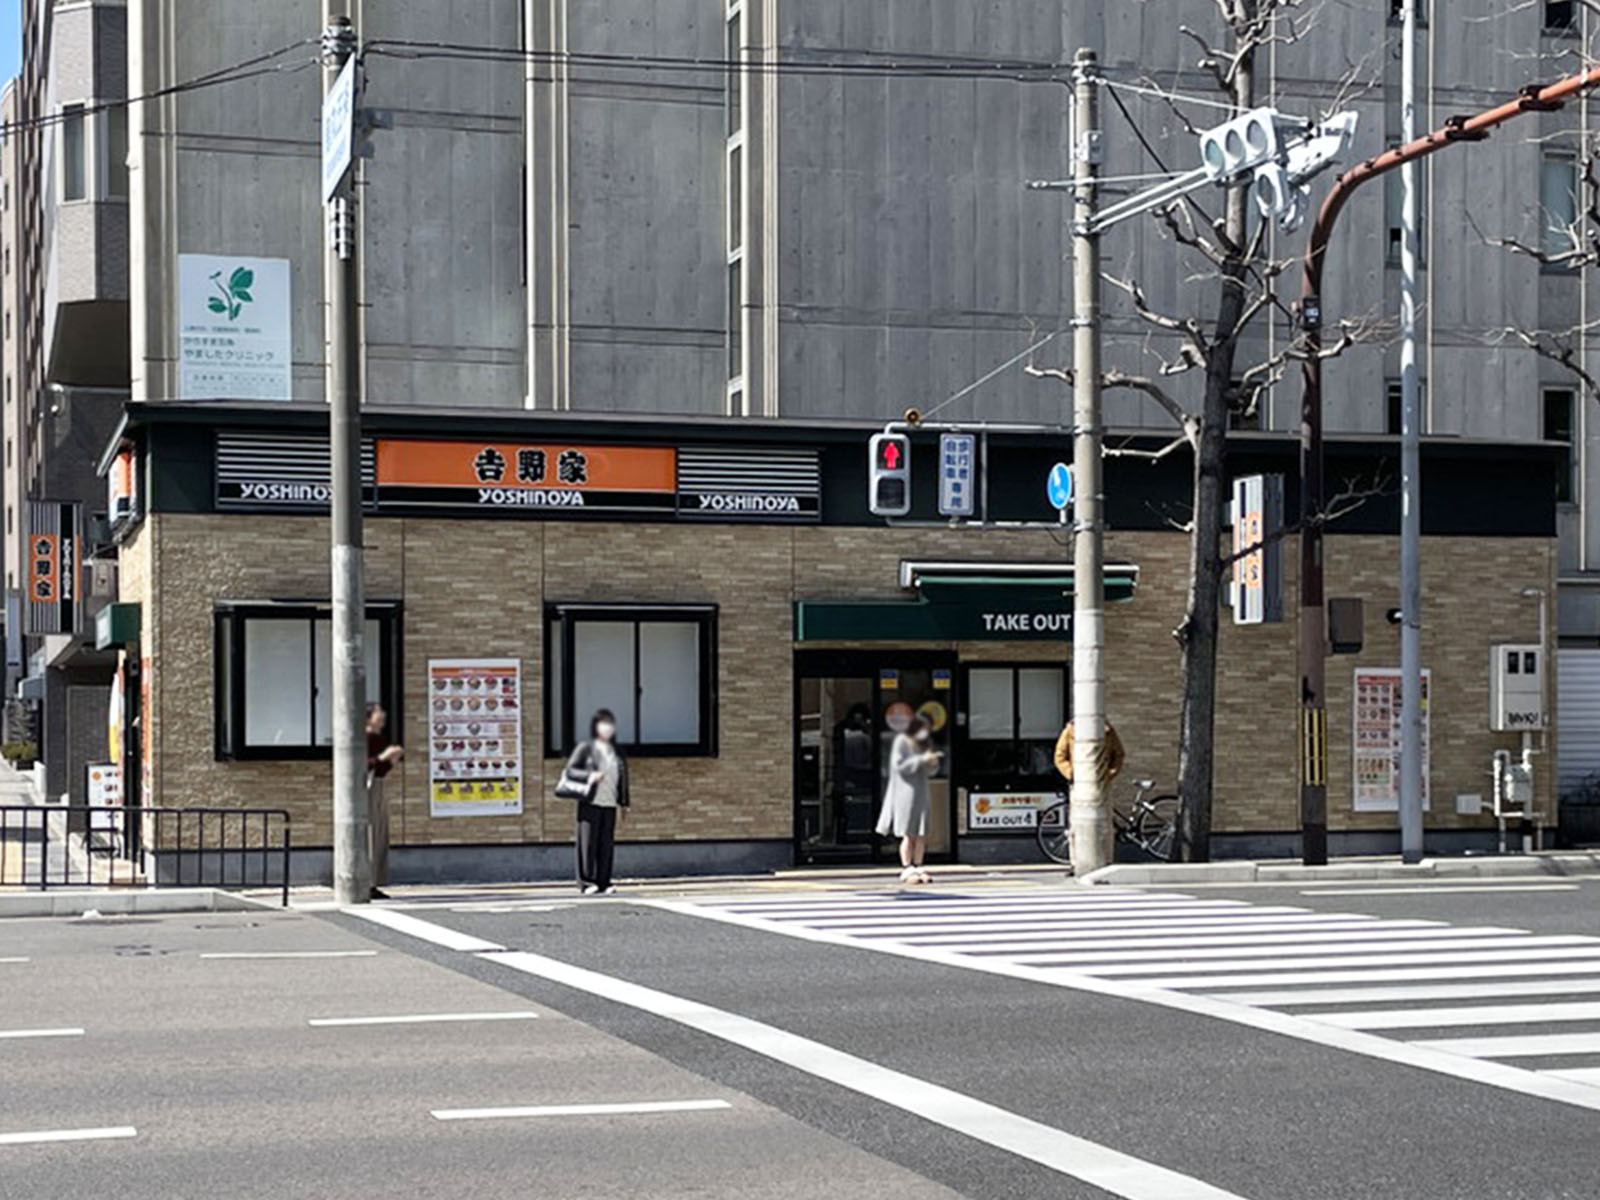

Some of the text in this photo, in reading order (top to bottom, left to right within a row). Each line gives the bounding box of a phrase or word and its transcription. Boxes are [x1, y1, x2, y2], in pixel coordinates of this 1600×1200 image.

[239, 483, 334, 501] YOSHINO
[478, 488, 585, 507] YOSHINOYA
[699, 494, 800, 512] YOSHINOYA
[982, 613, 1072, 631] TAKE OUT
